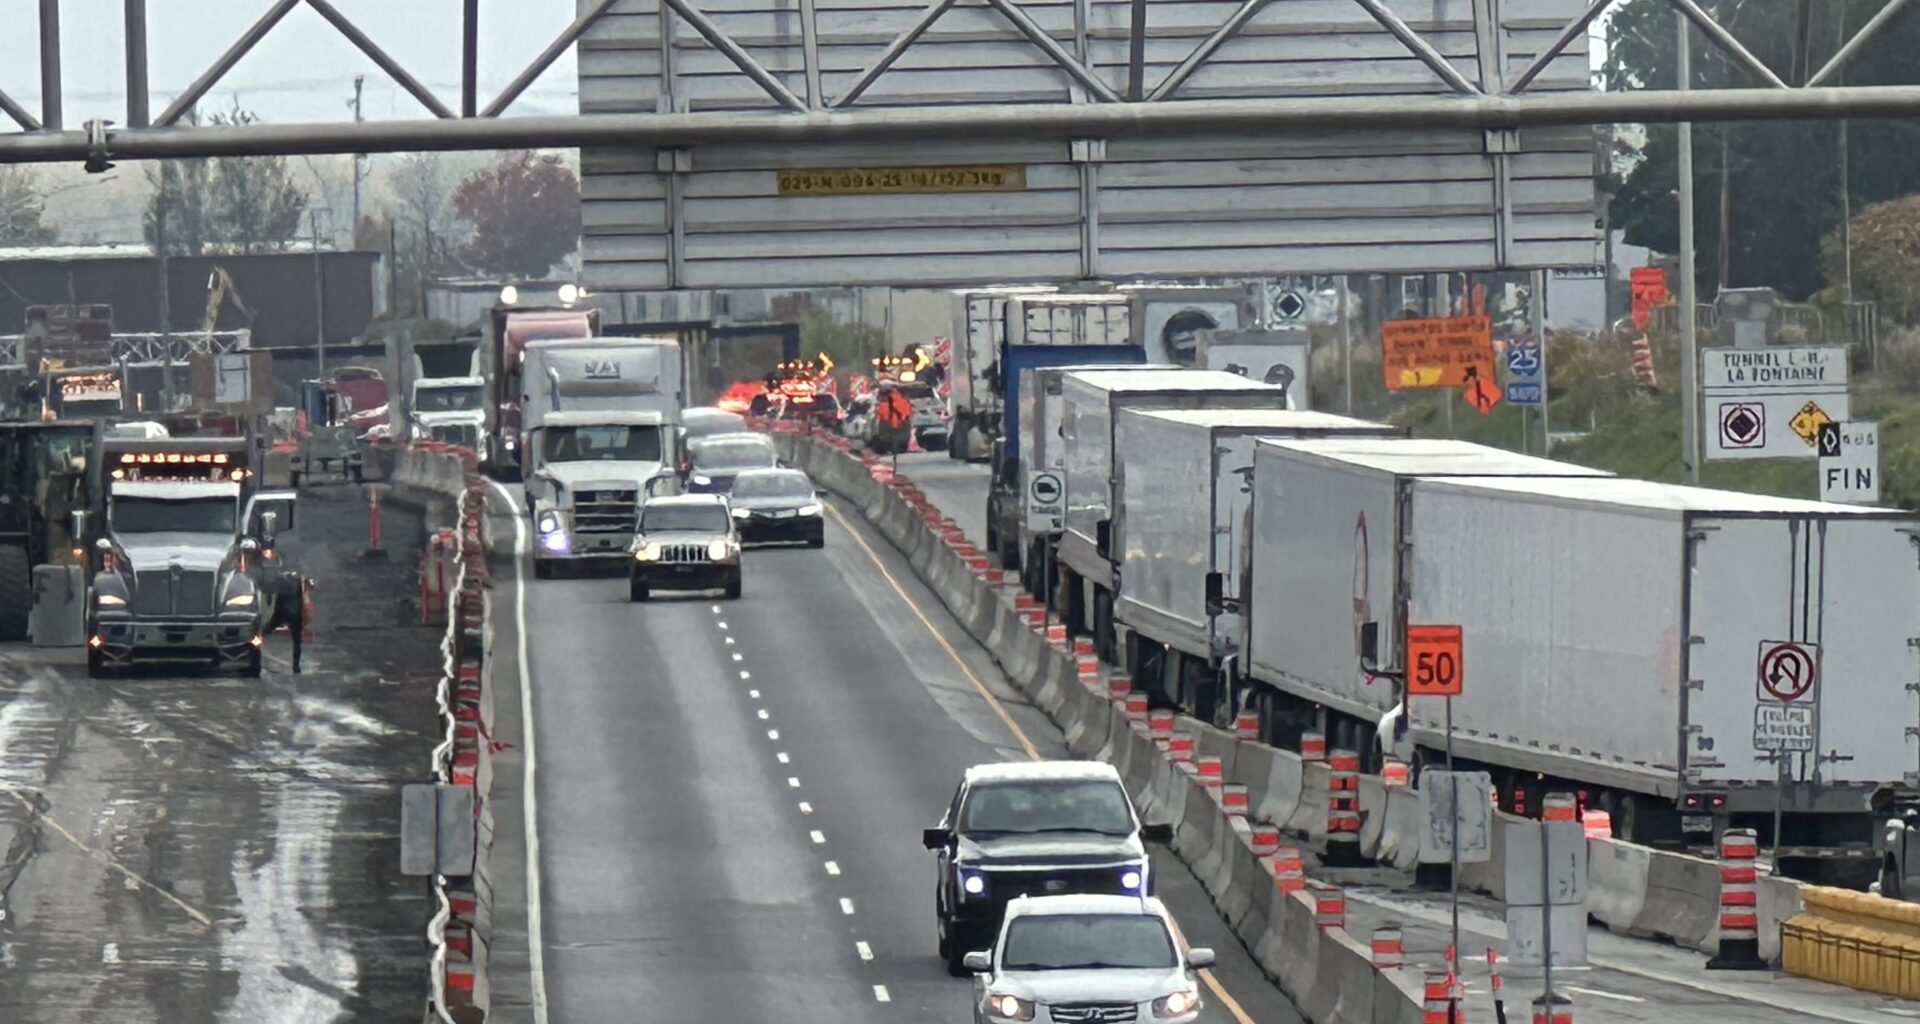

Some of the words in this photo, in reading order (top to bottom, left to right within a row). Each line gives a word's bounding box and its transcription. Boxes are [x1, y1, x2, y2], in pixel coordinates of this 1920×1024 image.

[1509, 348, 1538, 369] 25
[1724, 352, 1781, 367] TUNNEL
[1727, 369, 1744, 383] LA
[1826, 467, 1871, 491] FIN
[1416, 651, 1456, 686] 50
